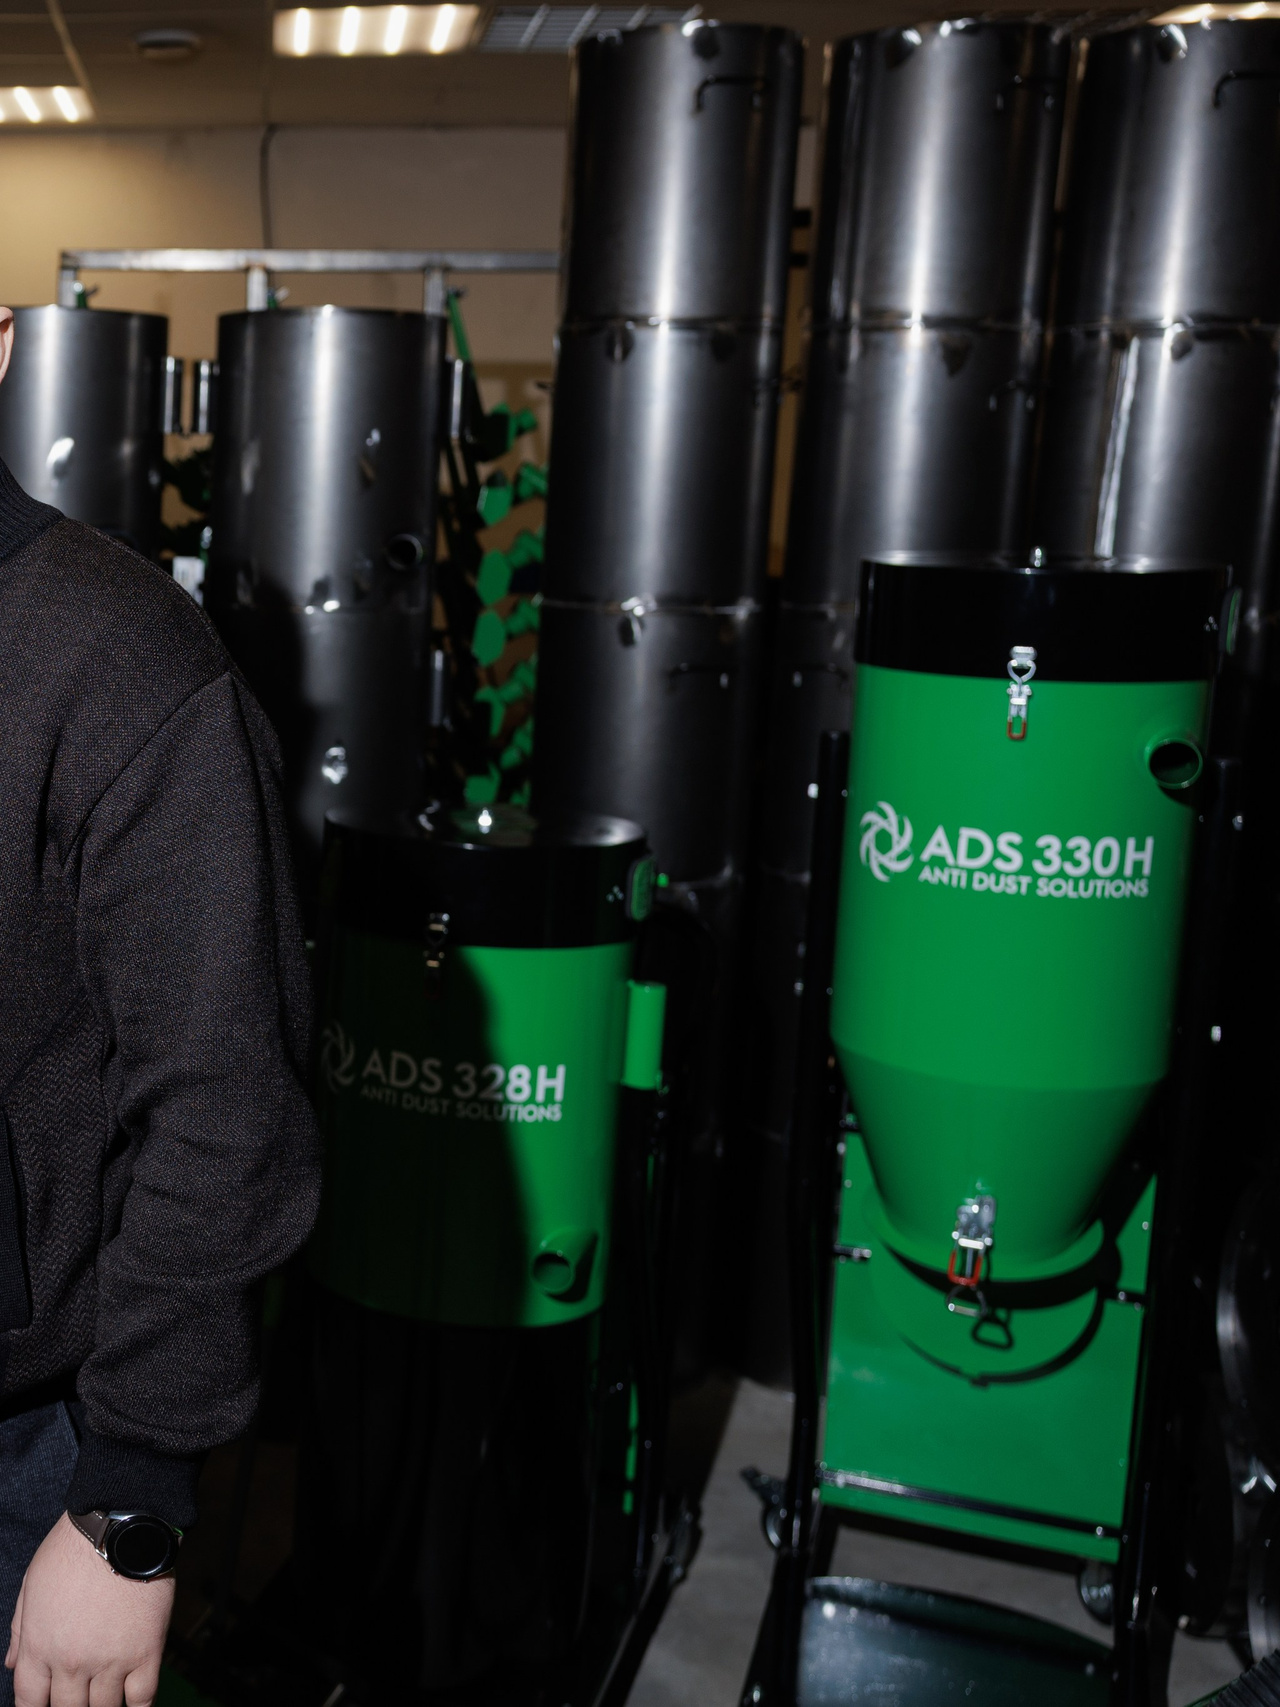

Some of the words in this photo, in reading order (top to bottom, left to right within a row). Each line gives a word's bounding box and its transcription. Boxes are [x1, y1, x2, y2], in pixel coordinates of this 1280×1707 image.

[919, 824, 1023, 873] ADS
[1031, 834, 1155, 878] 330H
[918, 865, 967, 889] ANTI
[971, 871, 1032, 896] DUST
[1035, 877, 1150, 899] SOLUTIONS
[361, 1048, 443, 1094] ADS
[450, 1061, 567, 1103] 328H
[360, 1085, 397, 1106] ANTI
[401, 1092, 450, 1116] DUST
[455, 1102, 563, 1123] SOLUTIONS
